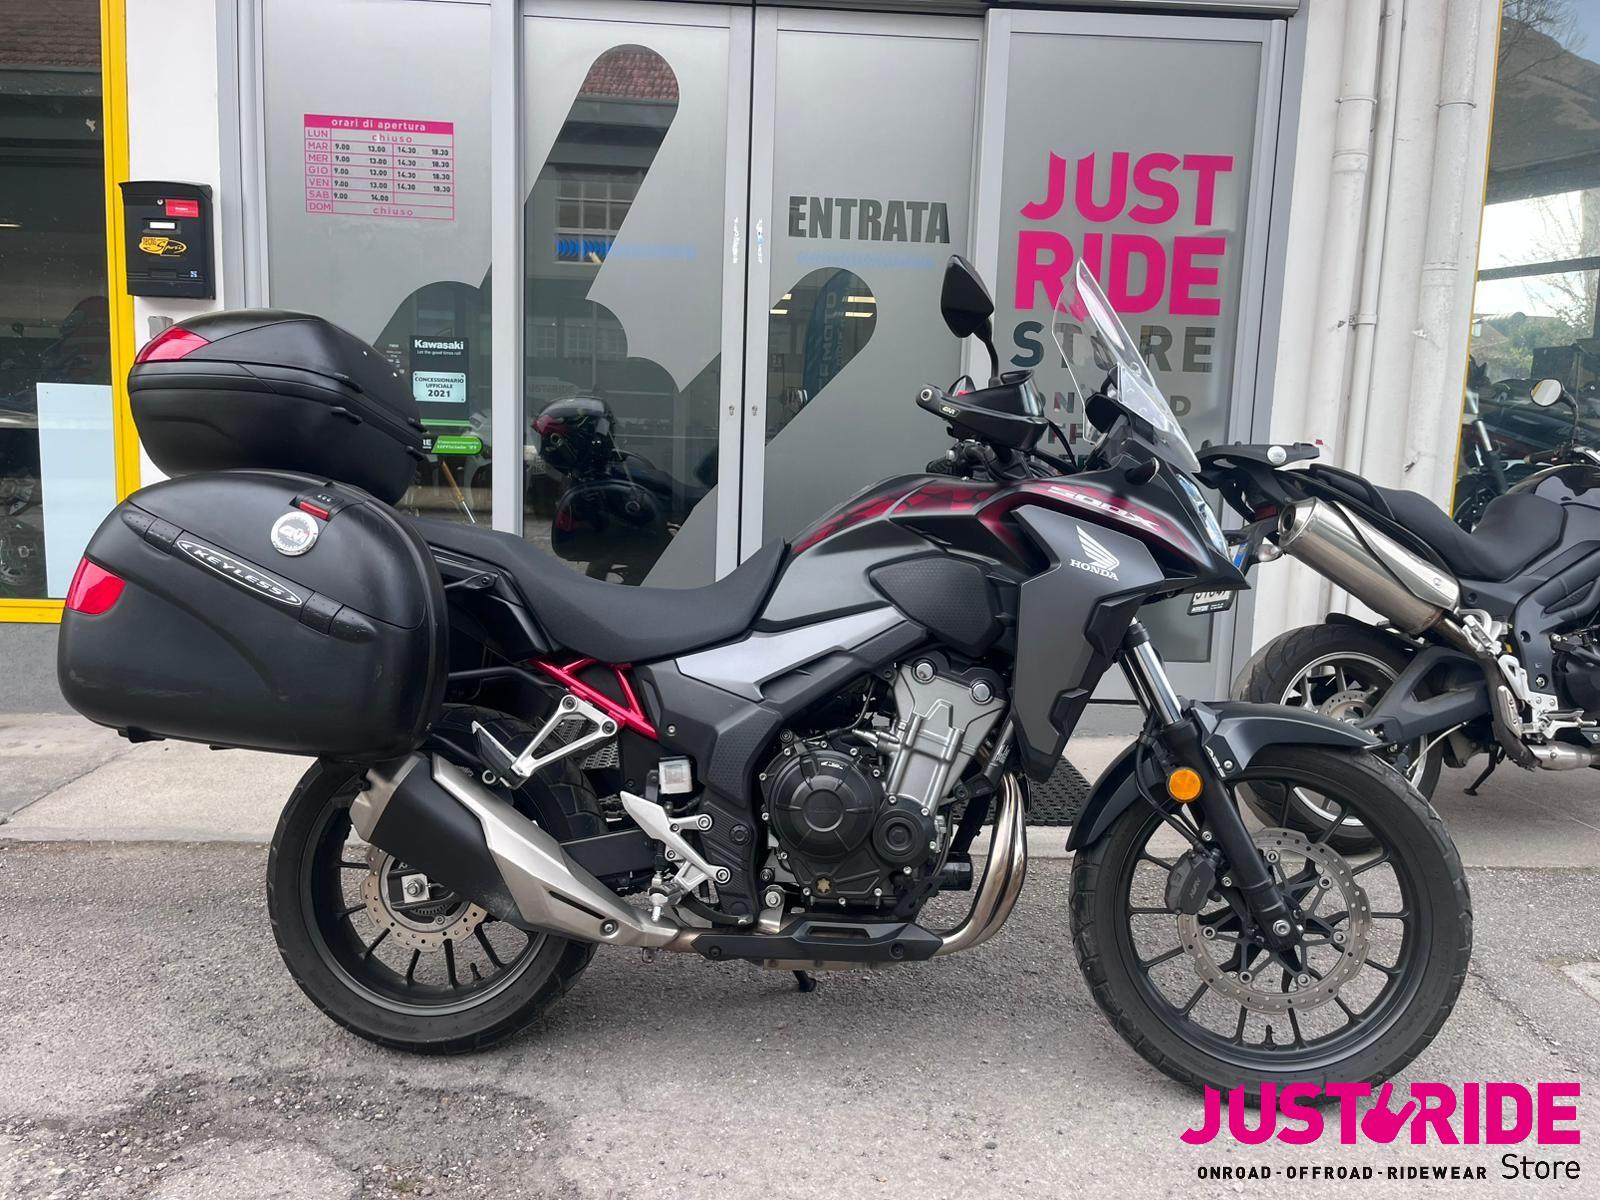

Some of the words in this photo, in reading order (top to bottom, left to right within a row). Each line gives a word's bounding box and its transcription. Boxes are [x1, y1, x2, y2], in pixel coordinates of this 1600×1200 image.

[331, 118, 359, 127] orari
[362, 119, 374, 128] di
[378, 120, 426, 132] apertura
[308, 130, 328, 138] LUN
[372, 134, 412, 143] chiuso
[308, 142, 328, 150] MAR
[308, 154, 328, 162] MER
[308, 166, 328, 174] GIO
[309, 178, 330, 186] VEN
[1020, 150, 1233, 226] JUST
[309, 190, 330, 199] SAB
[310, 202, 331, 211] DOM
[373, 207, 413, 216] chiuso
[788, 196, 950, 244] ENTRATA
[1015, 230, 1226, 316] RIDE
[414, 339, 464, 350] Kawasaki
[194, 550, 285, 595] KEYLESS
[1070, 559, 1119, 581] HONDA
